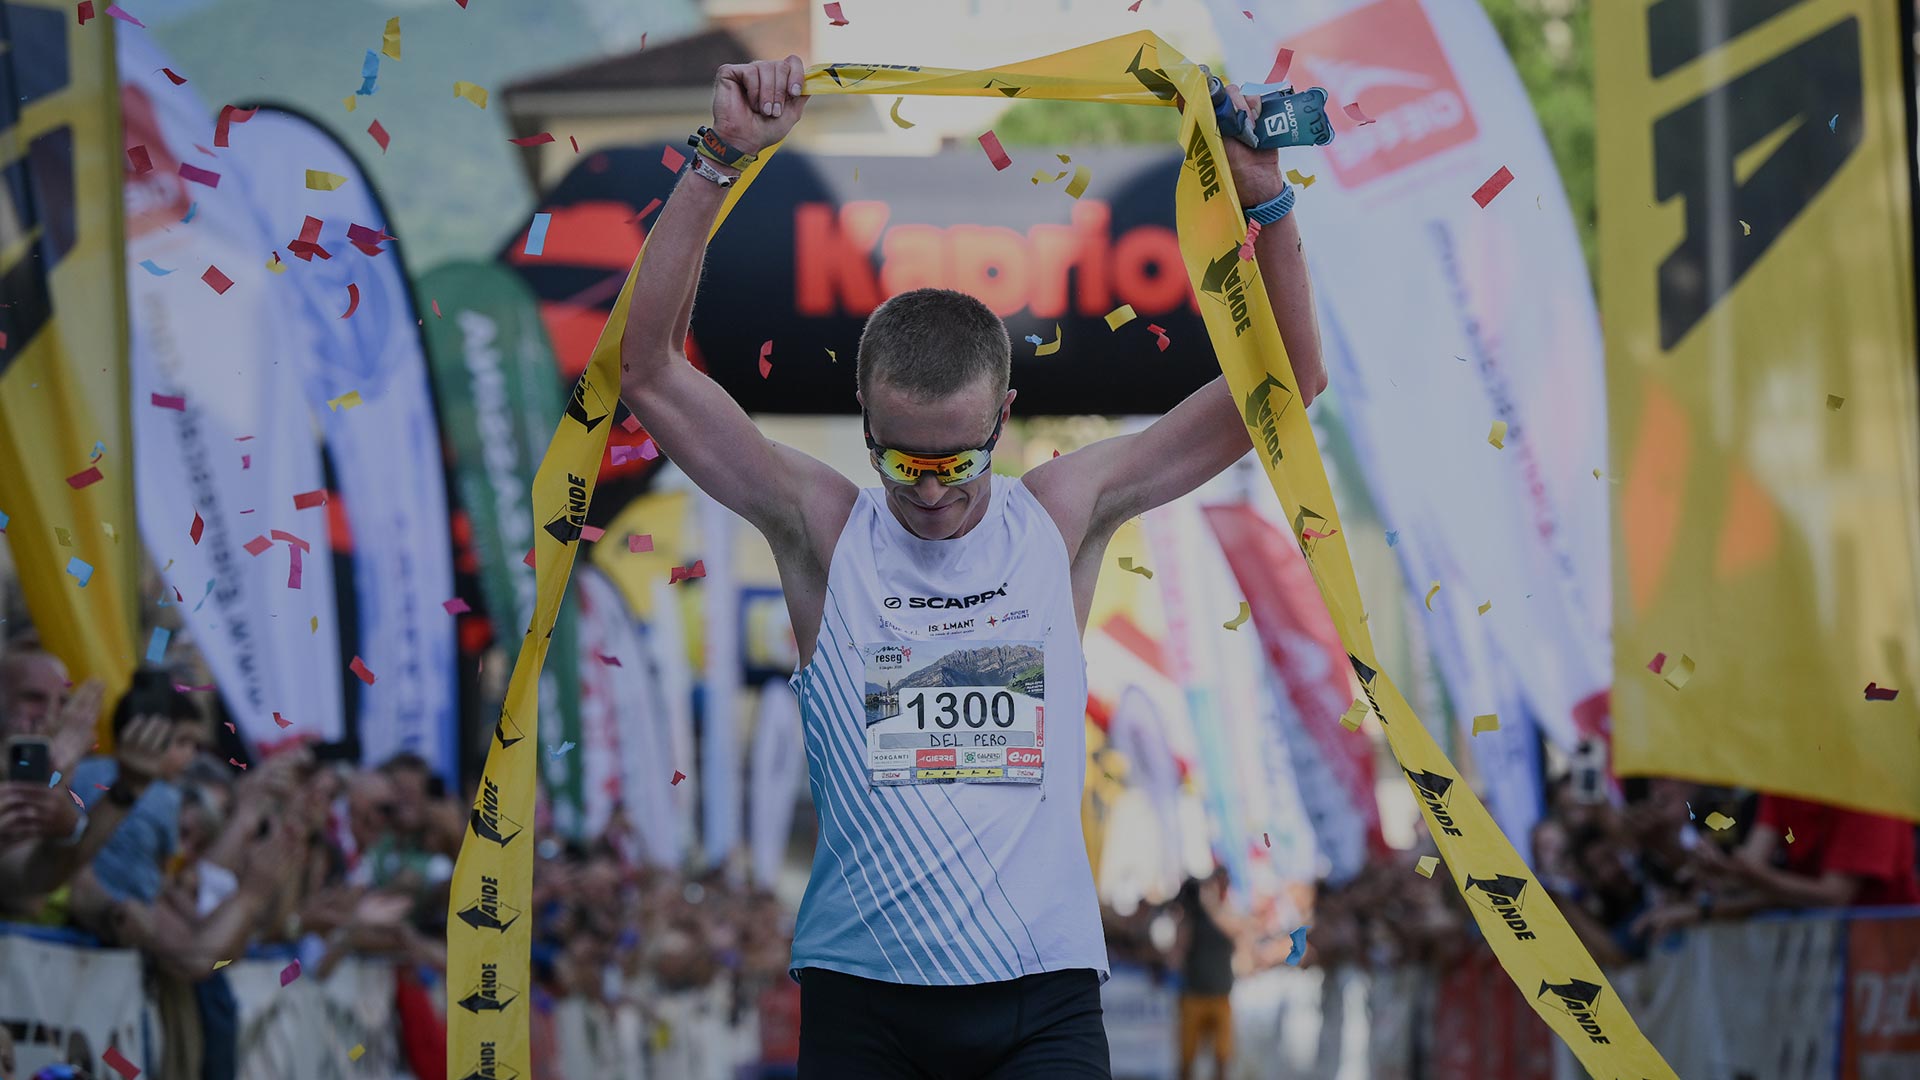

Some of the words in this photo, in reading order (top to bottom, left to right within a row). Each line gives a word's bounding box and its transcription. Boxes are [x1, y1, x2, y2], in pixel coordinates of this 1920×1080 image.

[795, 200, 1202, 317] Kaprio
[909, 586, 1007, 609] SCARPA
[928, 619, 975, 633] ISLMANT
[907, 691, 1015, 730] 1300
[926, 755, 954, 763] GIERRE
[930, 734, 963, 747] DEL
[974, 733, 1007, 747] PERO
[482, 775, 499, 831] ANDE
[1416, 784, 1463, 836] ANDE
[481, 875, 498, 918] ANDE
[1486, 893, 1536, 941] ANDE
[481, 963, 497, 999] ANDE
[1561, 998, 1610, 1045] ANDE
[480, 1041, 496, 1077] ANDE
